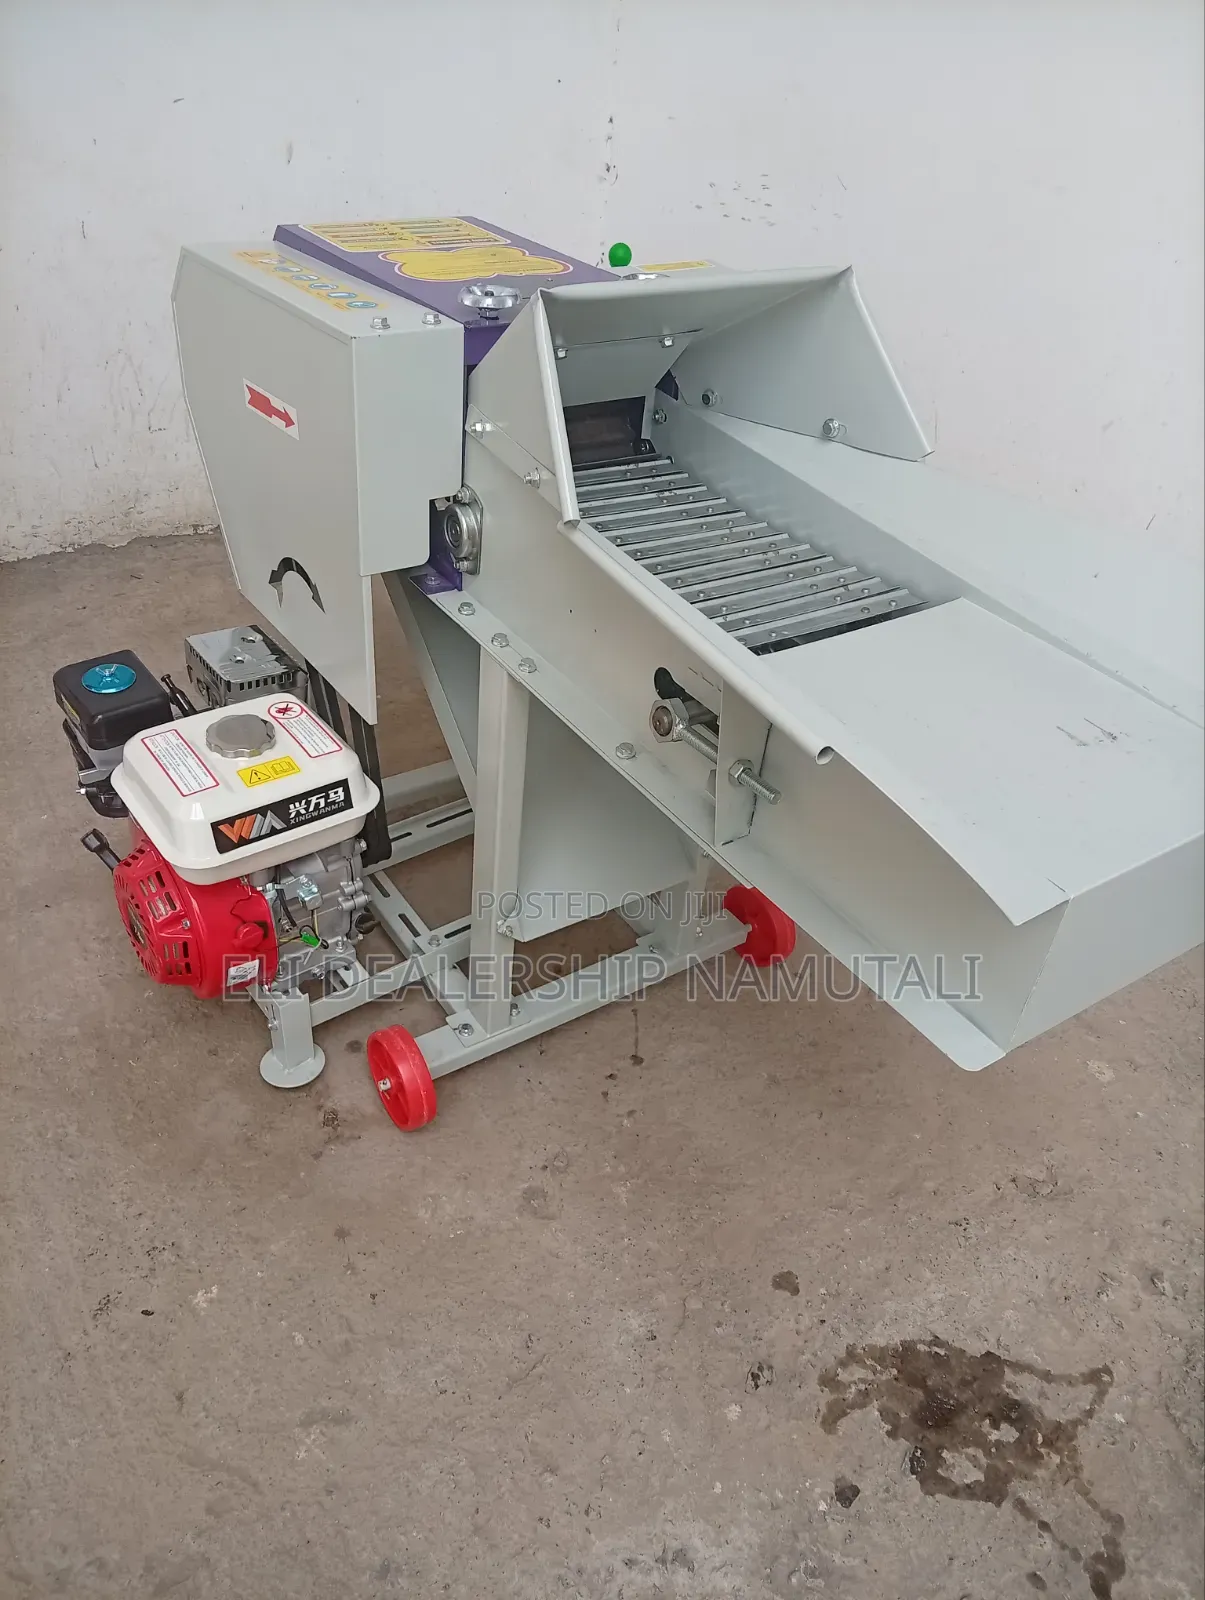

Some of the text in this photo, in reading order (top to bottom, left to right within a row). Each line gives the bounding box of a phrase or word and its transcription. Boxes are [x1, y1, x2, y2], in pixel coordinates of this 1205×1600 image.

[289, 786, 345, 819] 兴万马
[289, 801, 345, 825] XINGWANMA
